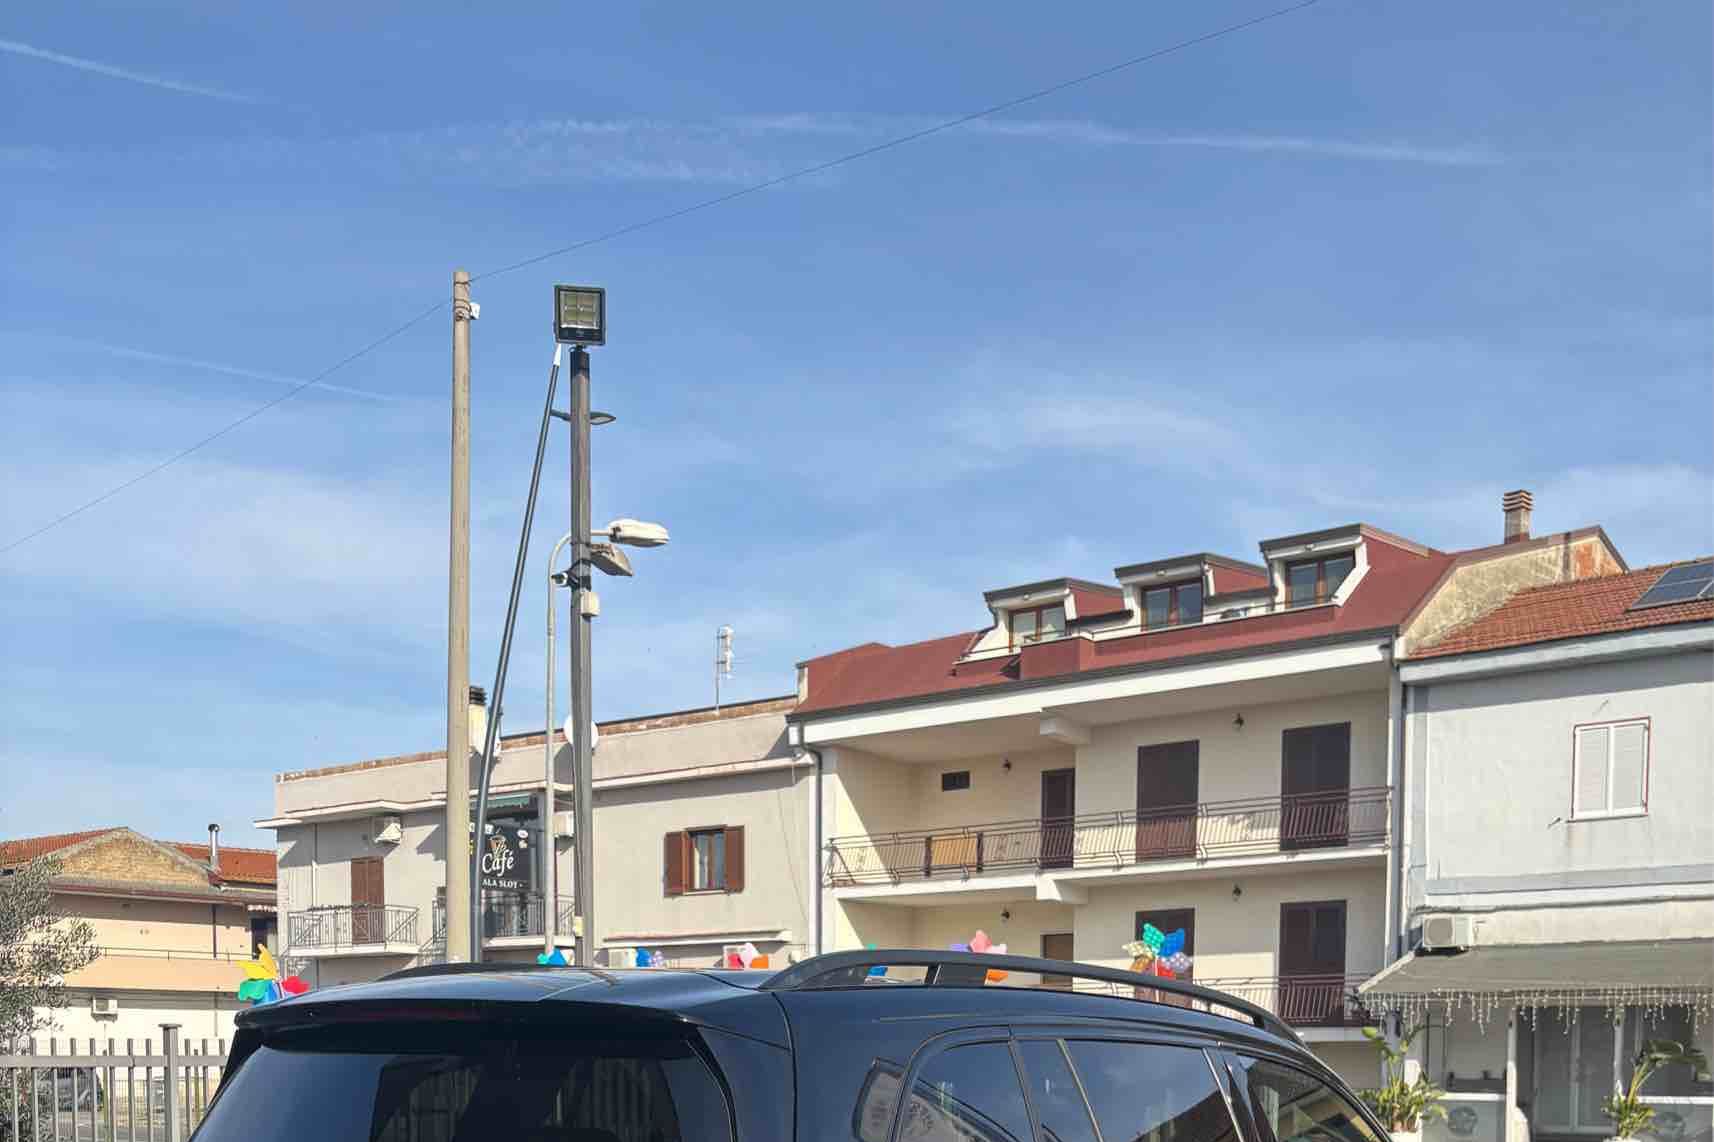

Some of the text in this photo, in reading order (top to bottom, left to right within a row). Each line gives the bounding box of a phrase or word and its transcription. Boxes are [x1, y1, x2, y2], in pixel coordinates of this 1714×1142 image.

[482, 848, 514, 877] Café
[481, 878, 518, 889] ALA SLOT
